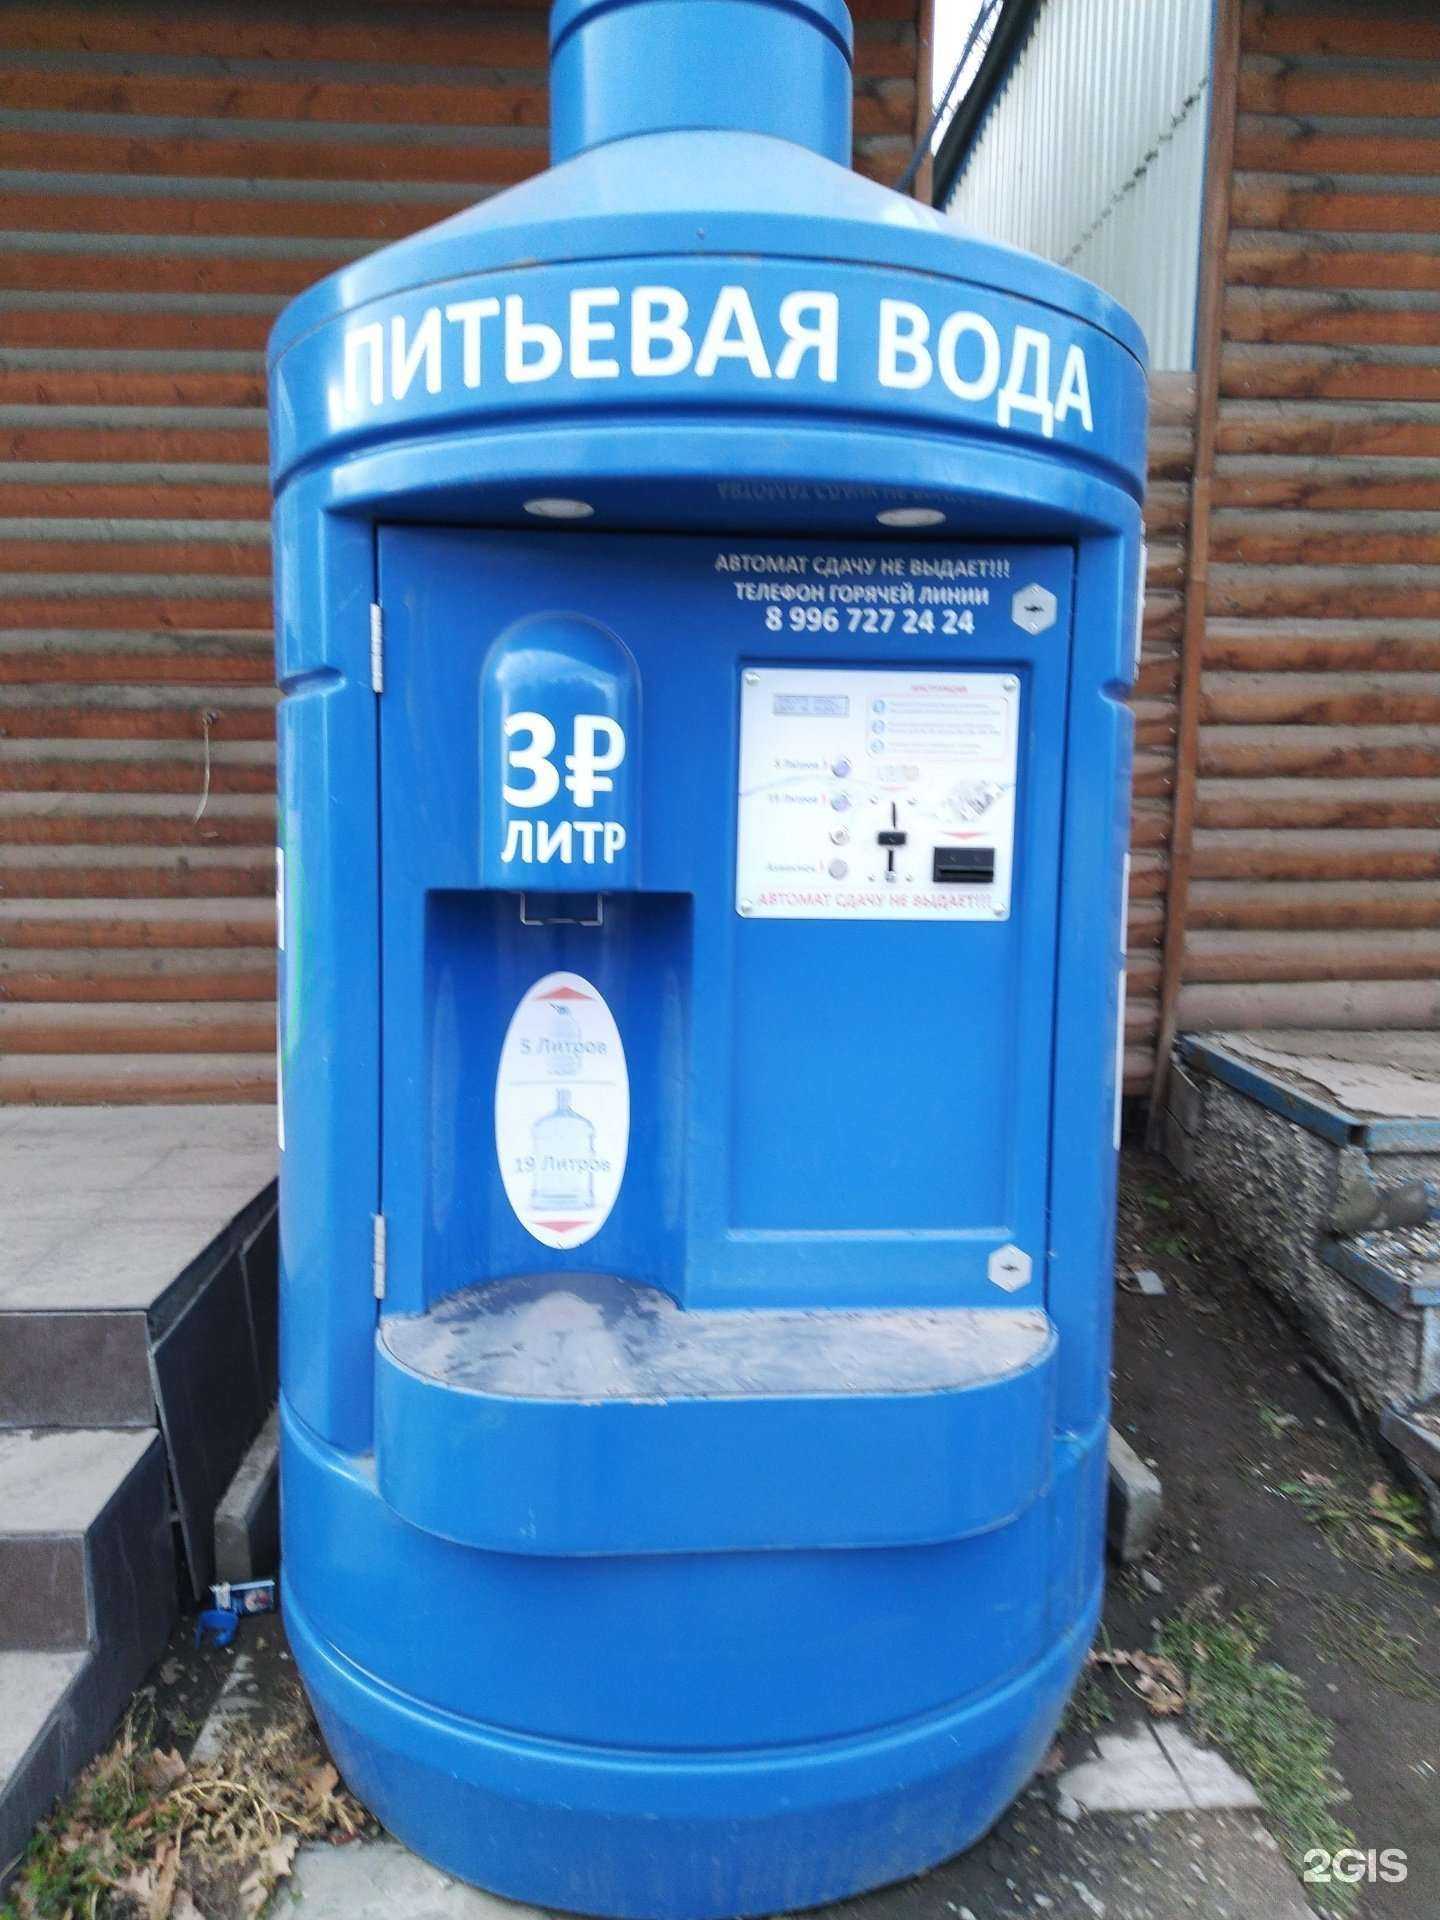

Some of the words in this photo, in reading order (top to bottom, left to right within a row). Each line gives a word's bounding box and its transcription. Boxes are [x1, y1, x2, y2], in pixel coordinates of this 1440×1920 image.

[343, 286, 839, 411] ПИТЬЕВАЯ
[878, 299, 1095, 437] ВОДА
[715, 553, 808, 574] АВТОМАТ
[812, 555, 876, 578] СДАЧУ
[880, 557, 905, 576] НЕ
[909, 557, 1010, 580] ВЫДАЕТ!!!
[734, 581, 825, 602] ТЕЛЕФОН
[829, 580, 915, 604] ГОРЯЧЕЙ
[918, 586, 989, 606] ЛИНИИ
[765, 605, 783, 632] 8
[788, 605, 840, 632] 996
[846, 606, 896, 634] 727
[901, 608, 935, 635] 24
[941, 608, 975, 635] 24
[500, 820, 627, 864] ЛИТР
[759, 893, 830, 907] АВТОМАТ
[519, 1038, 531, 1055] 5
[536, 1037, 608, 1056] Литров
[514, 1156, 536, 1173] 19
[541, 1156, 611, 1174] Литров
